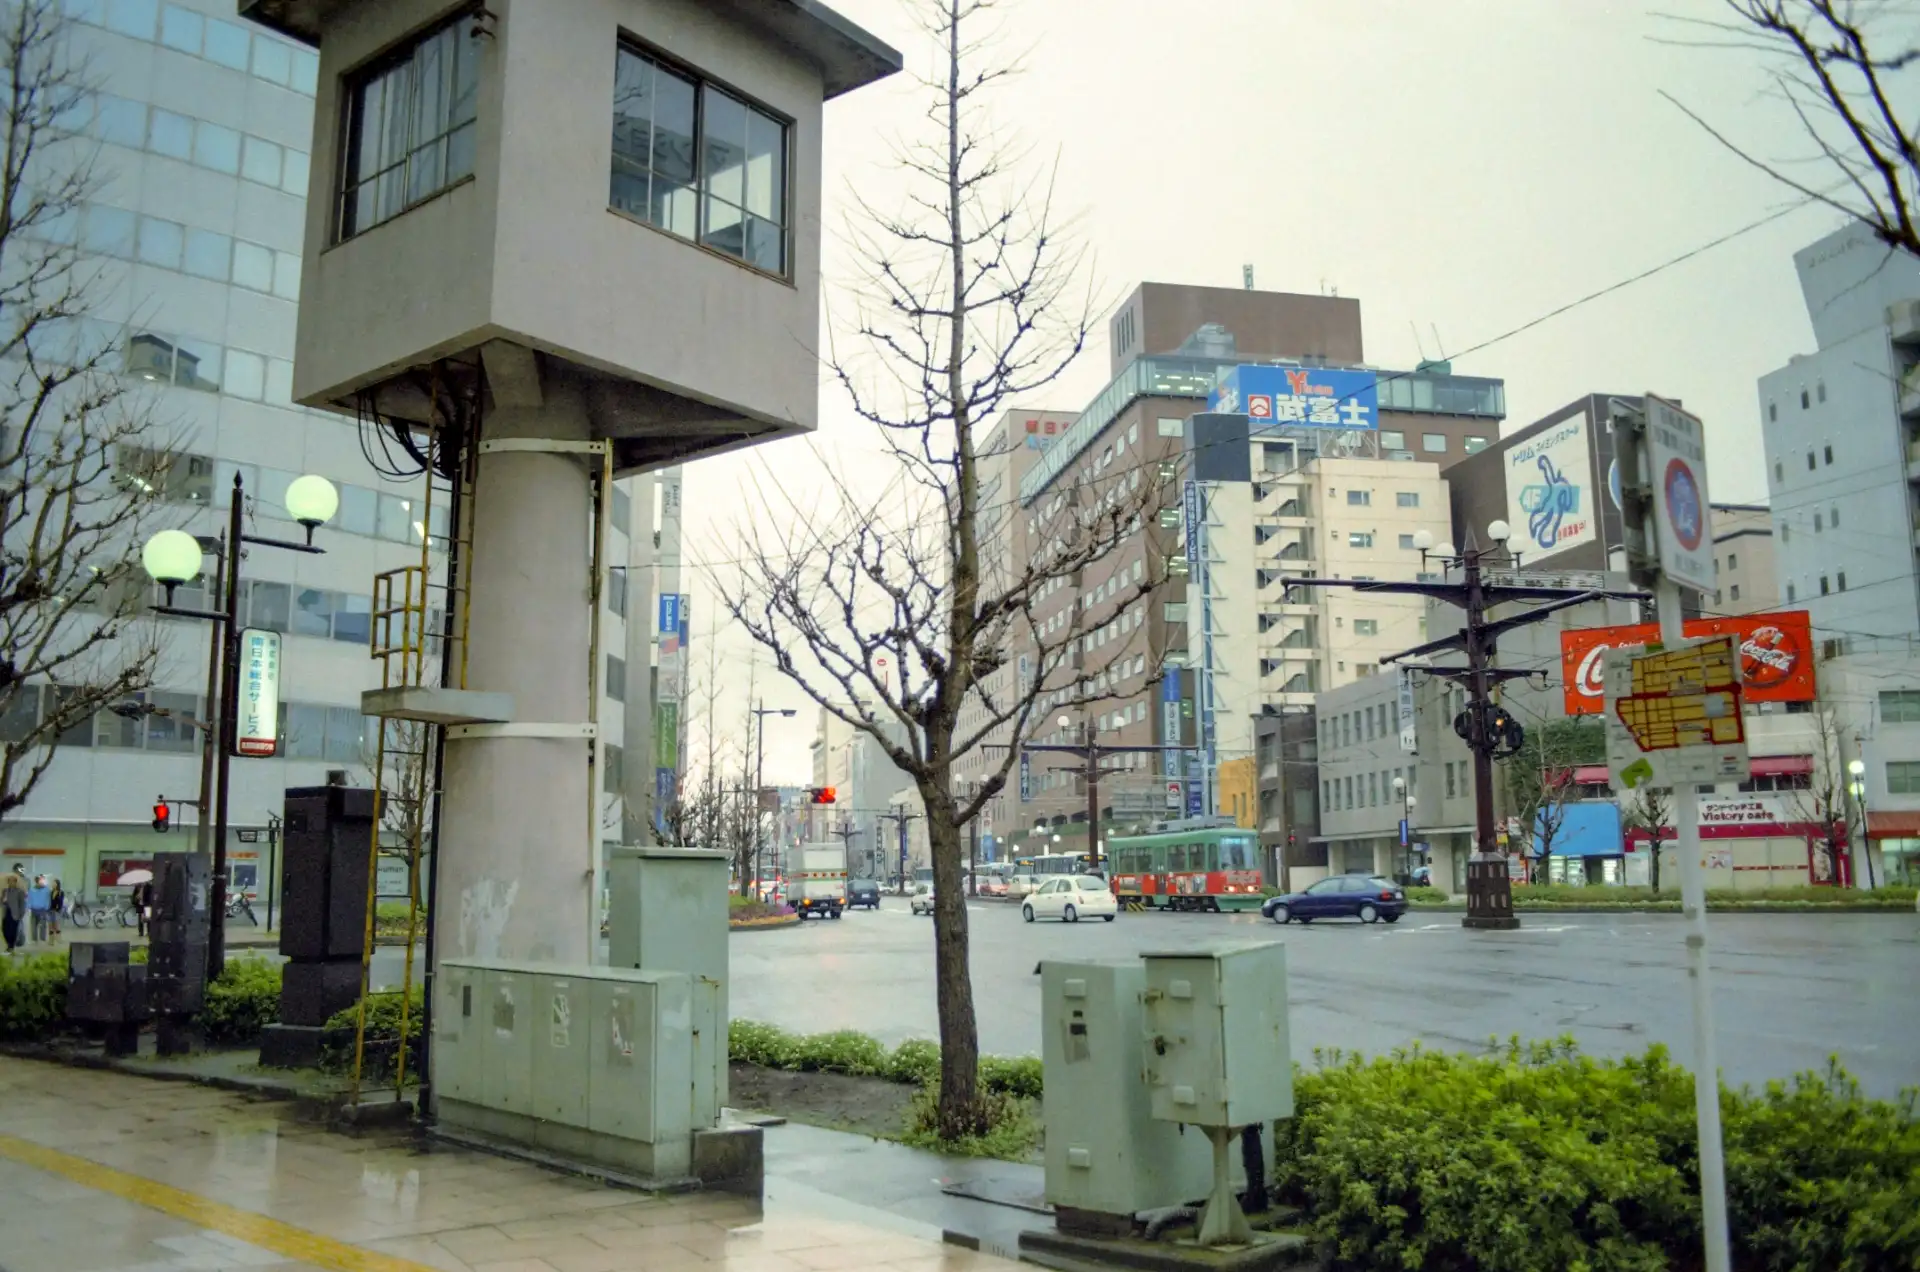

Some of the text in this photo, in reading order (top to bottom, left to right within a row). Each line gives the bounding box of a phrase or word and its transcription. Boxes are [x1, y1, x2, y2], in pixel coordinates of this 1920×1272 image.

[1276, 393, 1370, 426] 武富士
[1702, 811, 1744, 821] Victory
